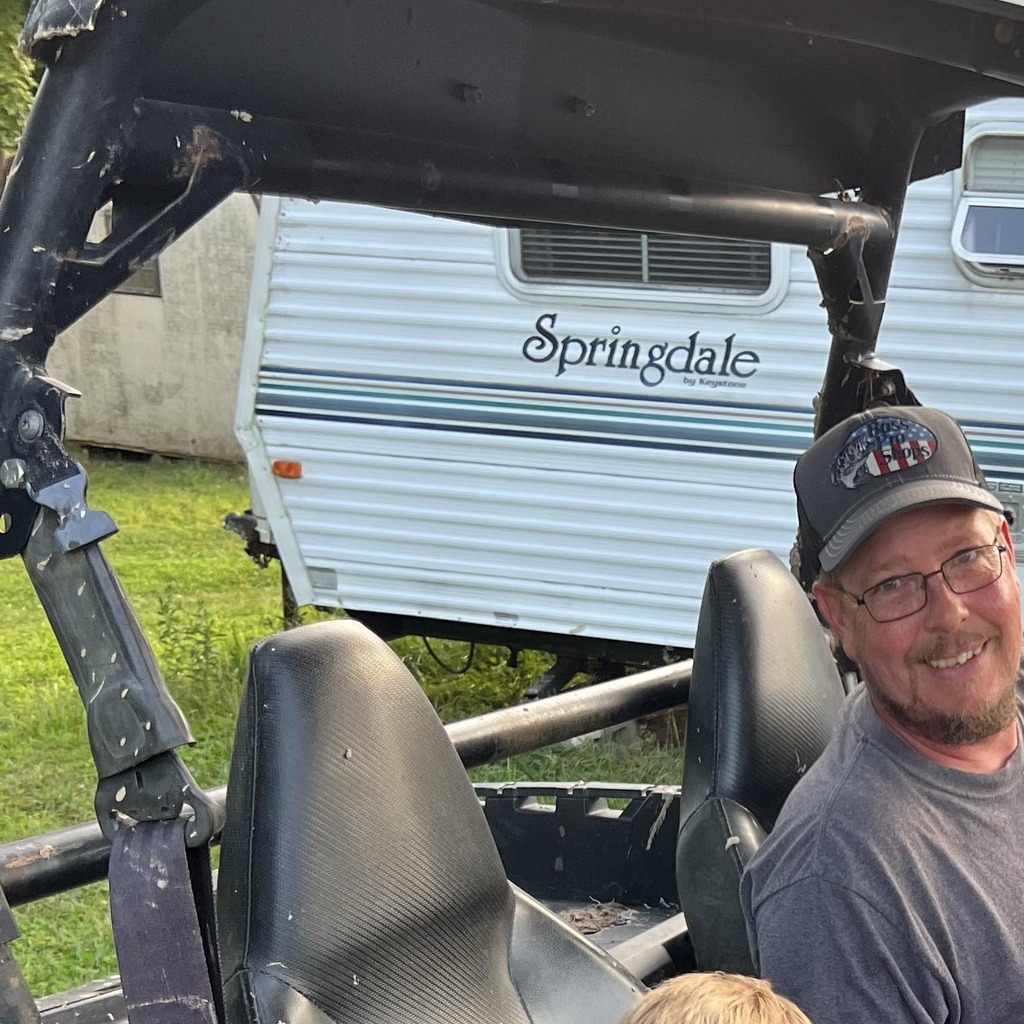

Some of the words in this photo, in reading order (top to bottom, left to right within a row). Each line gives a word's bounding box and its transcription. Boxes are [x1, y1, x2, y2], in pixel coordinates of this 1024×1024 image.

[522, 312, 761, 387] Springdale
[683, 376, 696, 387] by
[699, 377, 747, 389] Keystone
